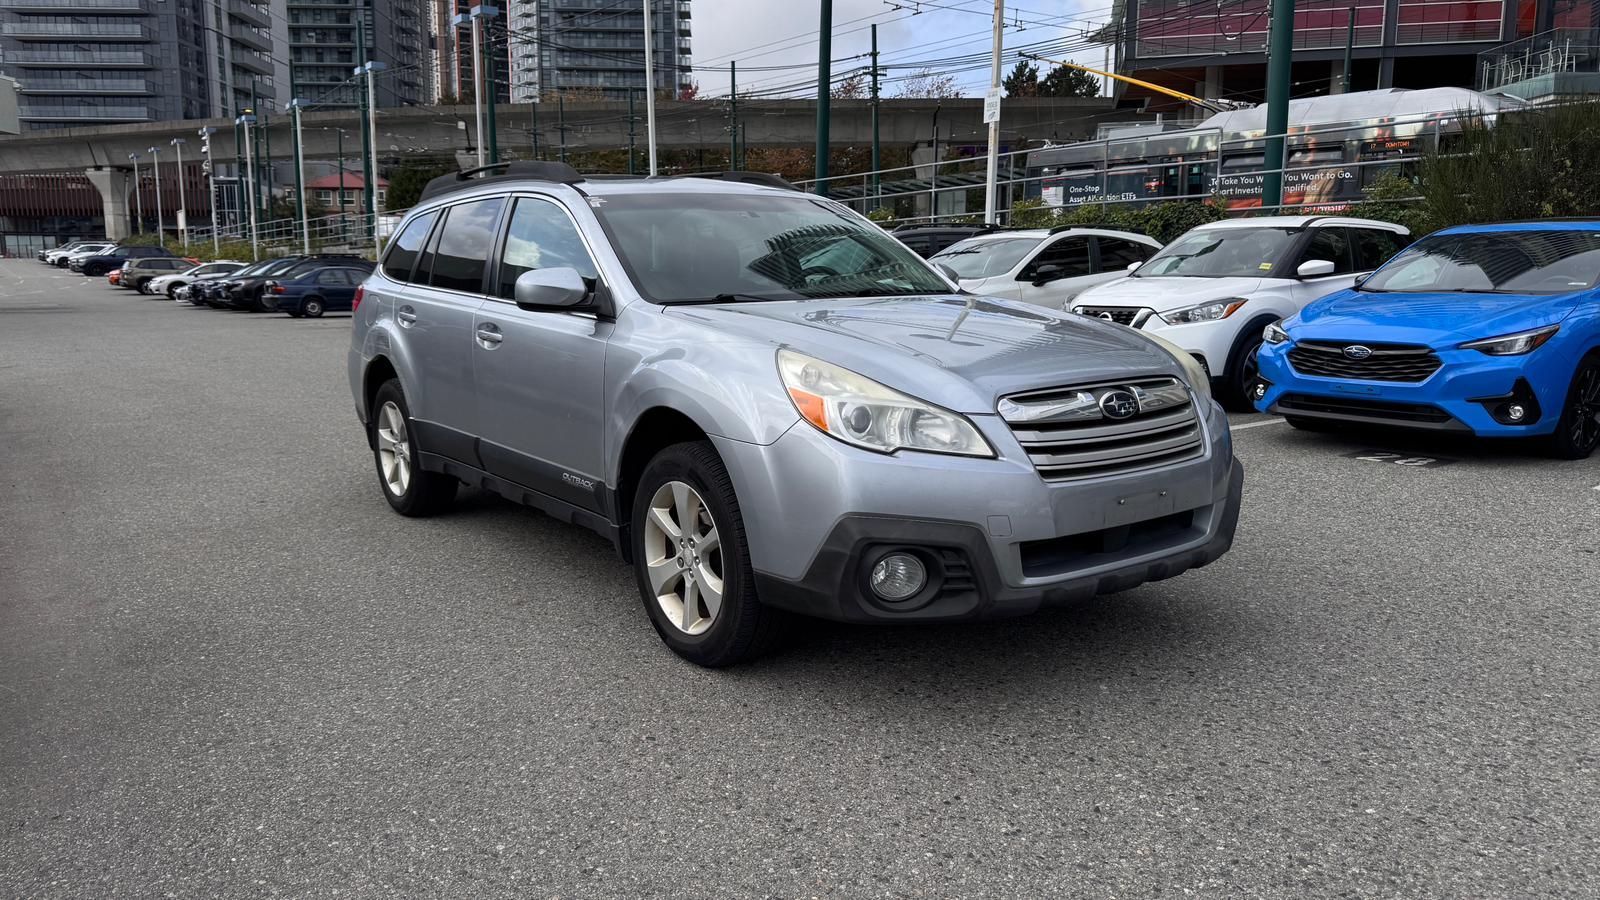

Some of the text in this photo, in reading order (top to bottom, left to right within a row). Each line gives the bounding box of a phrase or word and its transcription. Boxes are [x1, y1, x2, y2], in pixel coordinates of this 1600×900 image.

[1221, 177, 1238, 185] Take
[1240, 176, 1254, 184] You
[1284, 173, 1298, 181] You
[1301, 172, 1324, 180] Want
[1326, 172, 1335, 180] to
[1337, 170, 1353, 179] Go.
[1069, 184, 1100, 193] One-Stop
[1069, 195, 1086, 203] Asset
[1121, 192, 1136, 200] ETFs
[562, 472, 594, 489] OUTBACK
